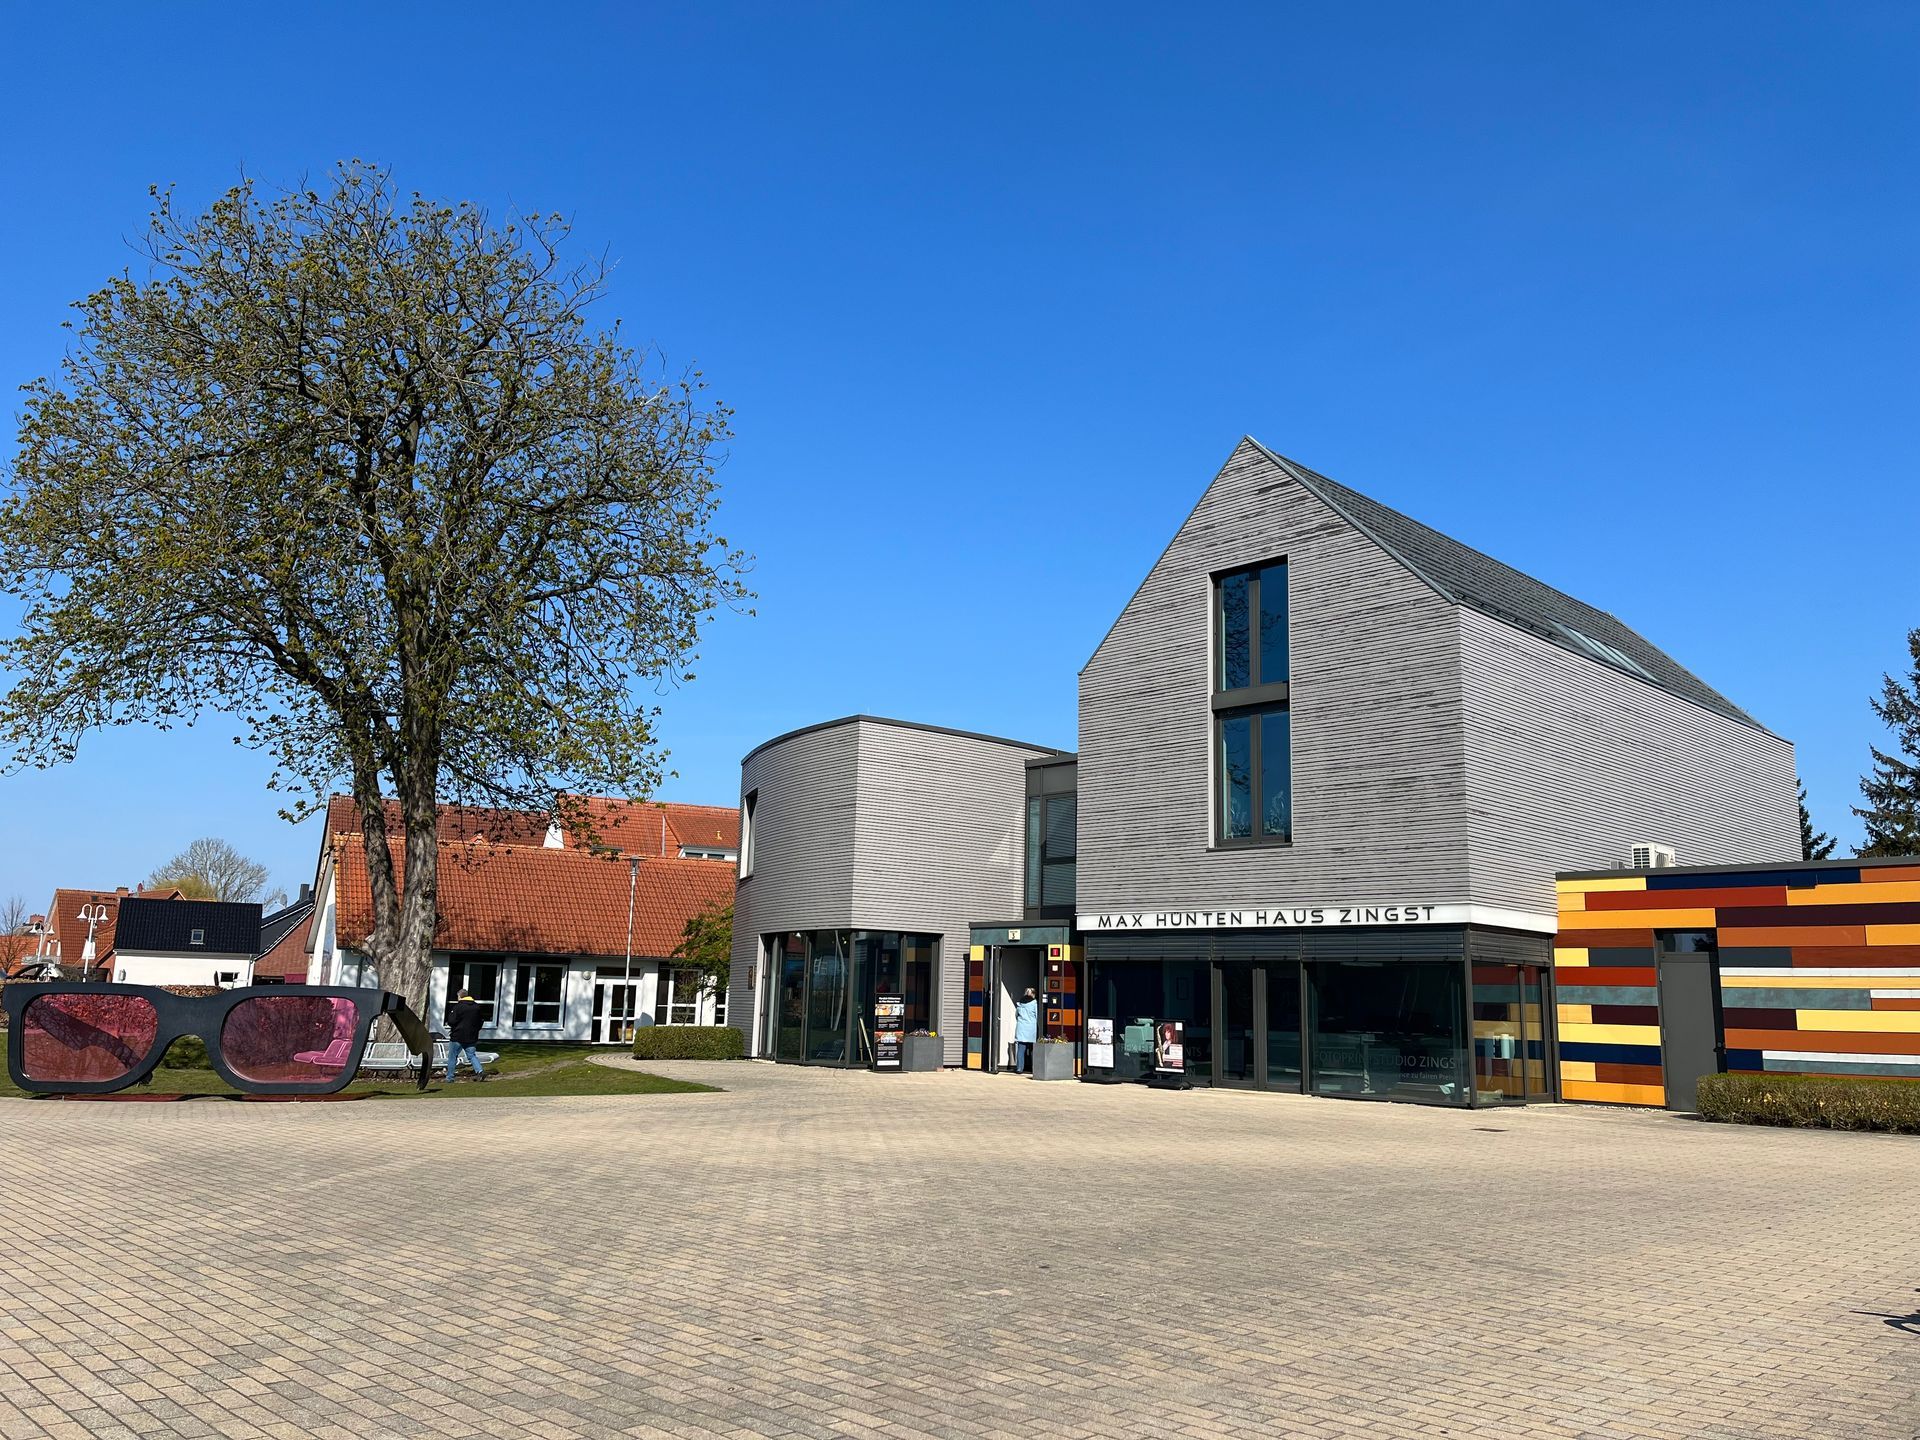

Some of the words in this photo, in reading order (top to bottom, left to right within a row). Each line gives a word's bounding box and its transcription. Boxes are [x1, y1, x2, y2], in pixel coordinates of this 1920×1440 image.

[1098, 914, 1143, 928] MAX
[1156, 910, 1242, 927] HÜNTEN
[1256, 909, 1324, 925] HAUS
[1339, 906, 1436, 923] ZINGST
[1419, 1055, 1457, 1069] ZINGS
